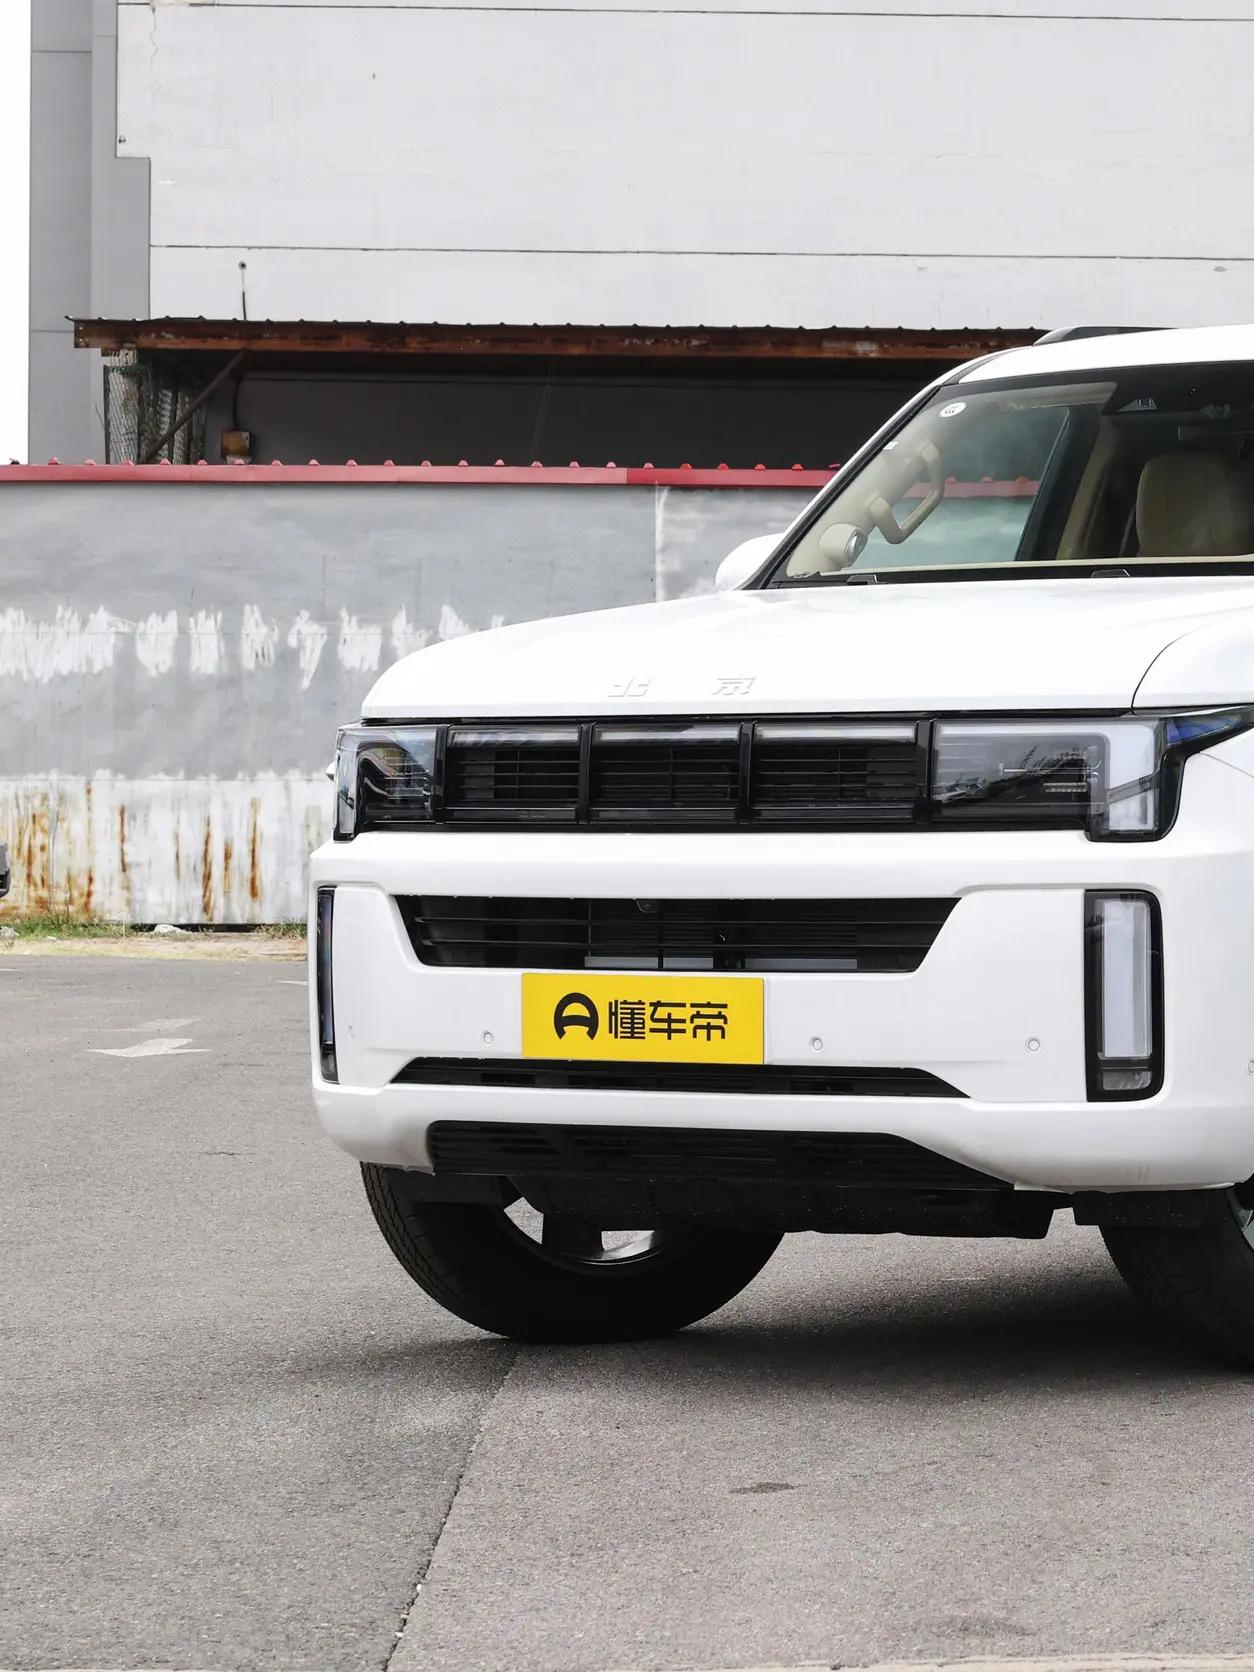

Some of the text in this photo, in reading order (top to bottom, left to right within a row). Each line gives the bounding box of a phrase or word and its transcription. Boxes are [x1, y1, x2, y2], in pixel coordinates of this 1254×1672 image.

[607, 674, 756, 698] 北京
[608, 999, 728, 1041] 懂车帝
